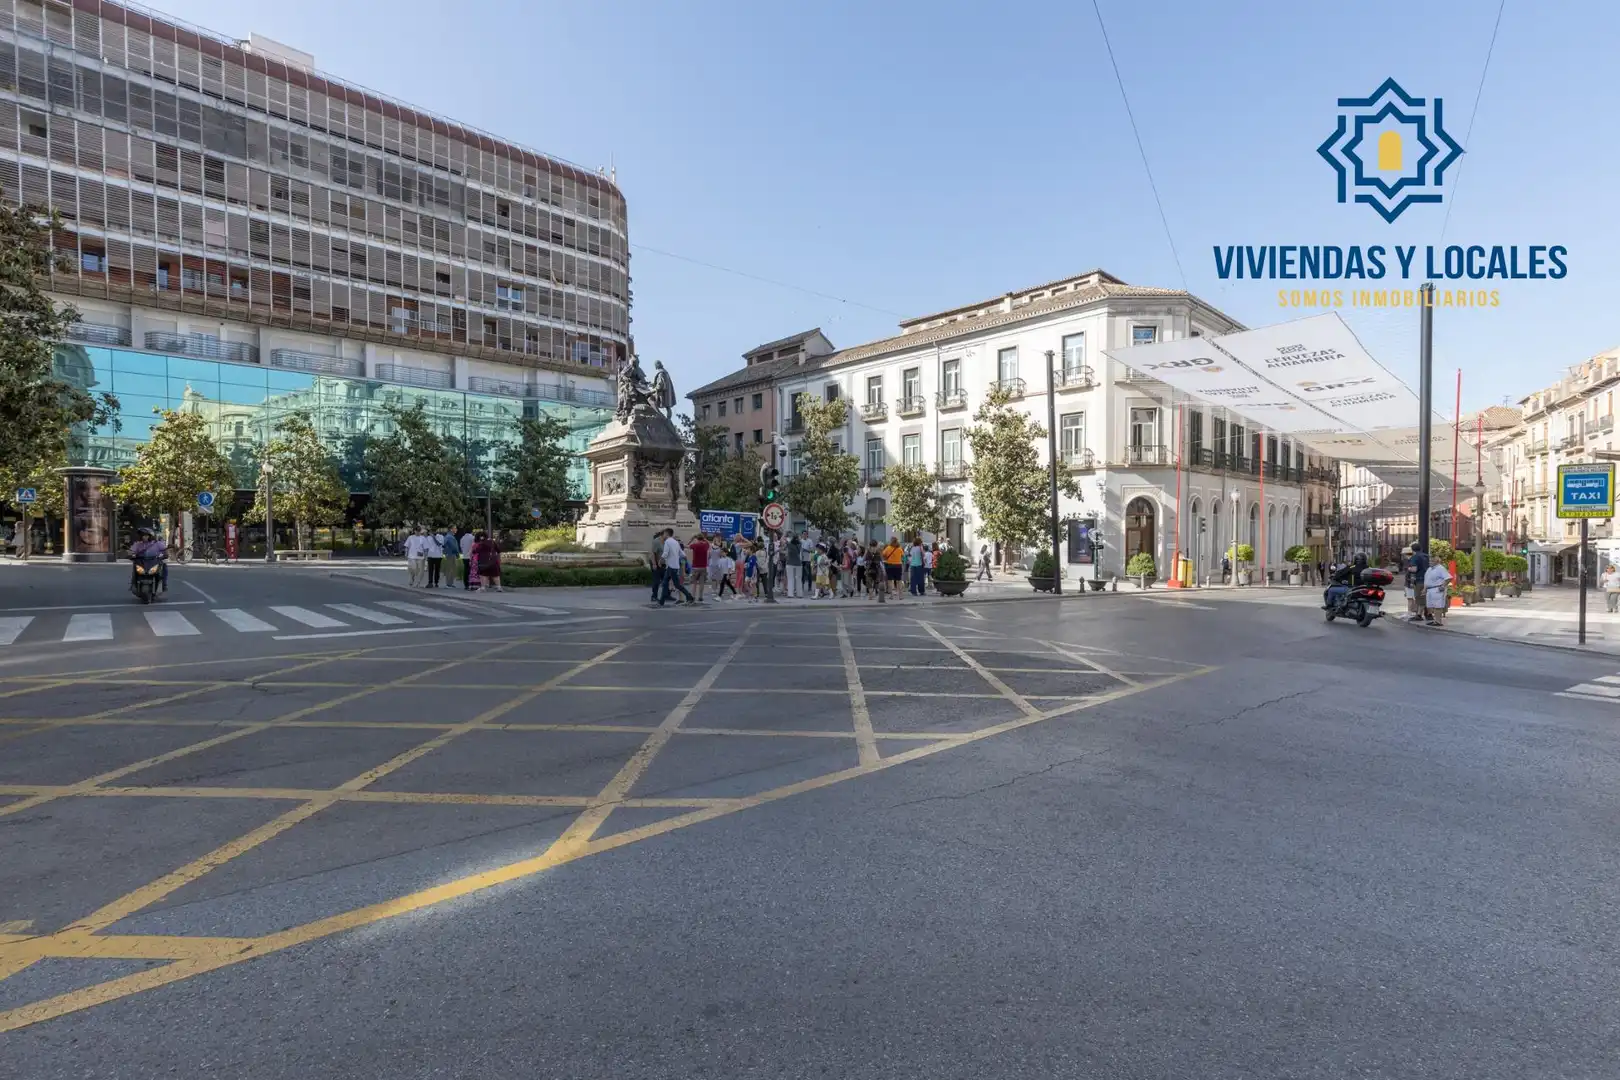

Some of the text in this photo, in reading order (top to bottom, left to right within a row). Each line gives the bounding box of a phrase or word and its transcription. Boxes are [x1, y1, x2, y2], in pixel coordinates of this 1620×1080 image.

[1264, 348, 1337, 364] CERVEZAS
[1267, 353, 1346, 369] ALHAMBRA
[1570, 492, 1601, 500] TAXI
[702, 514, 734, 524] atlanta
